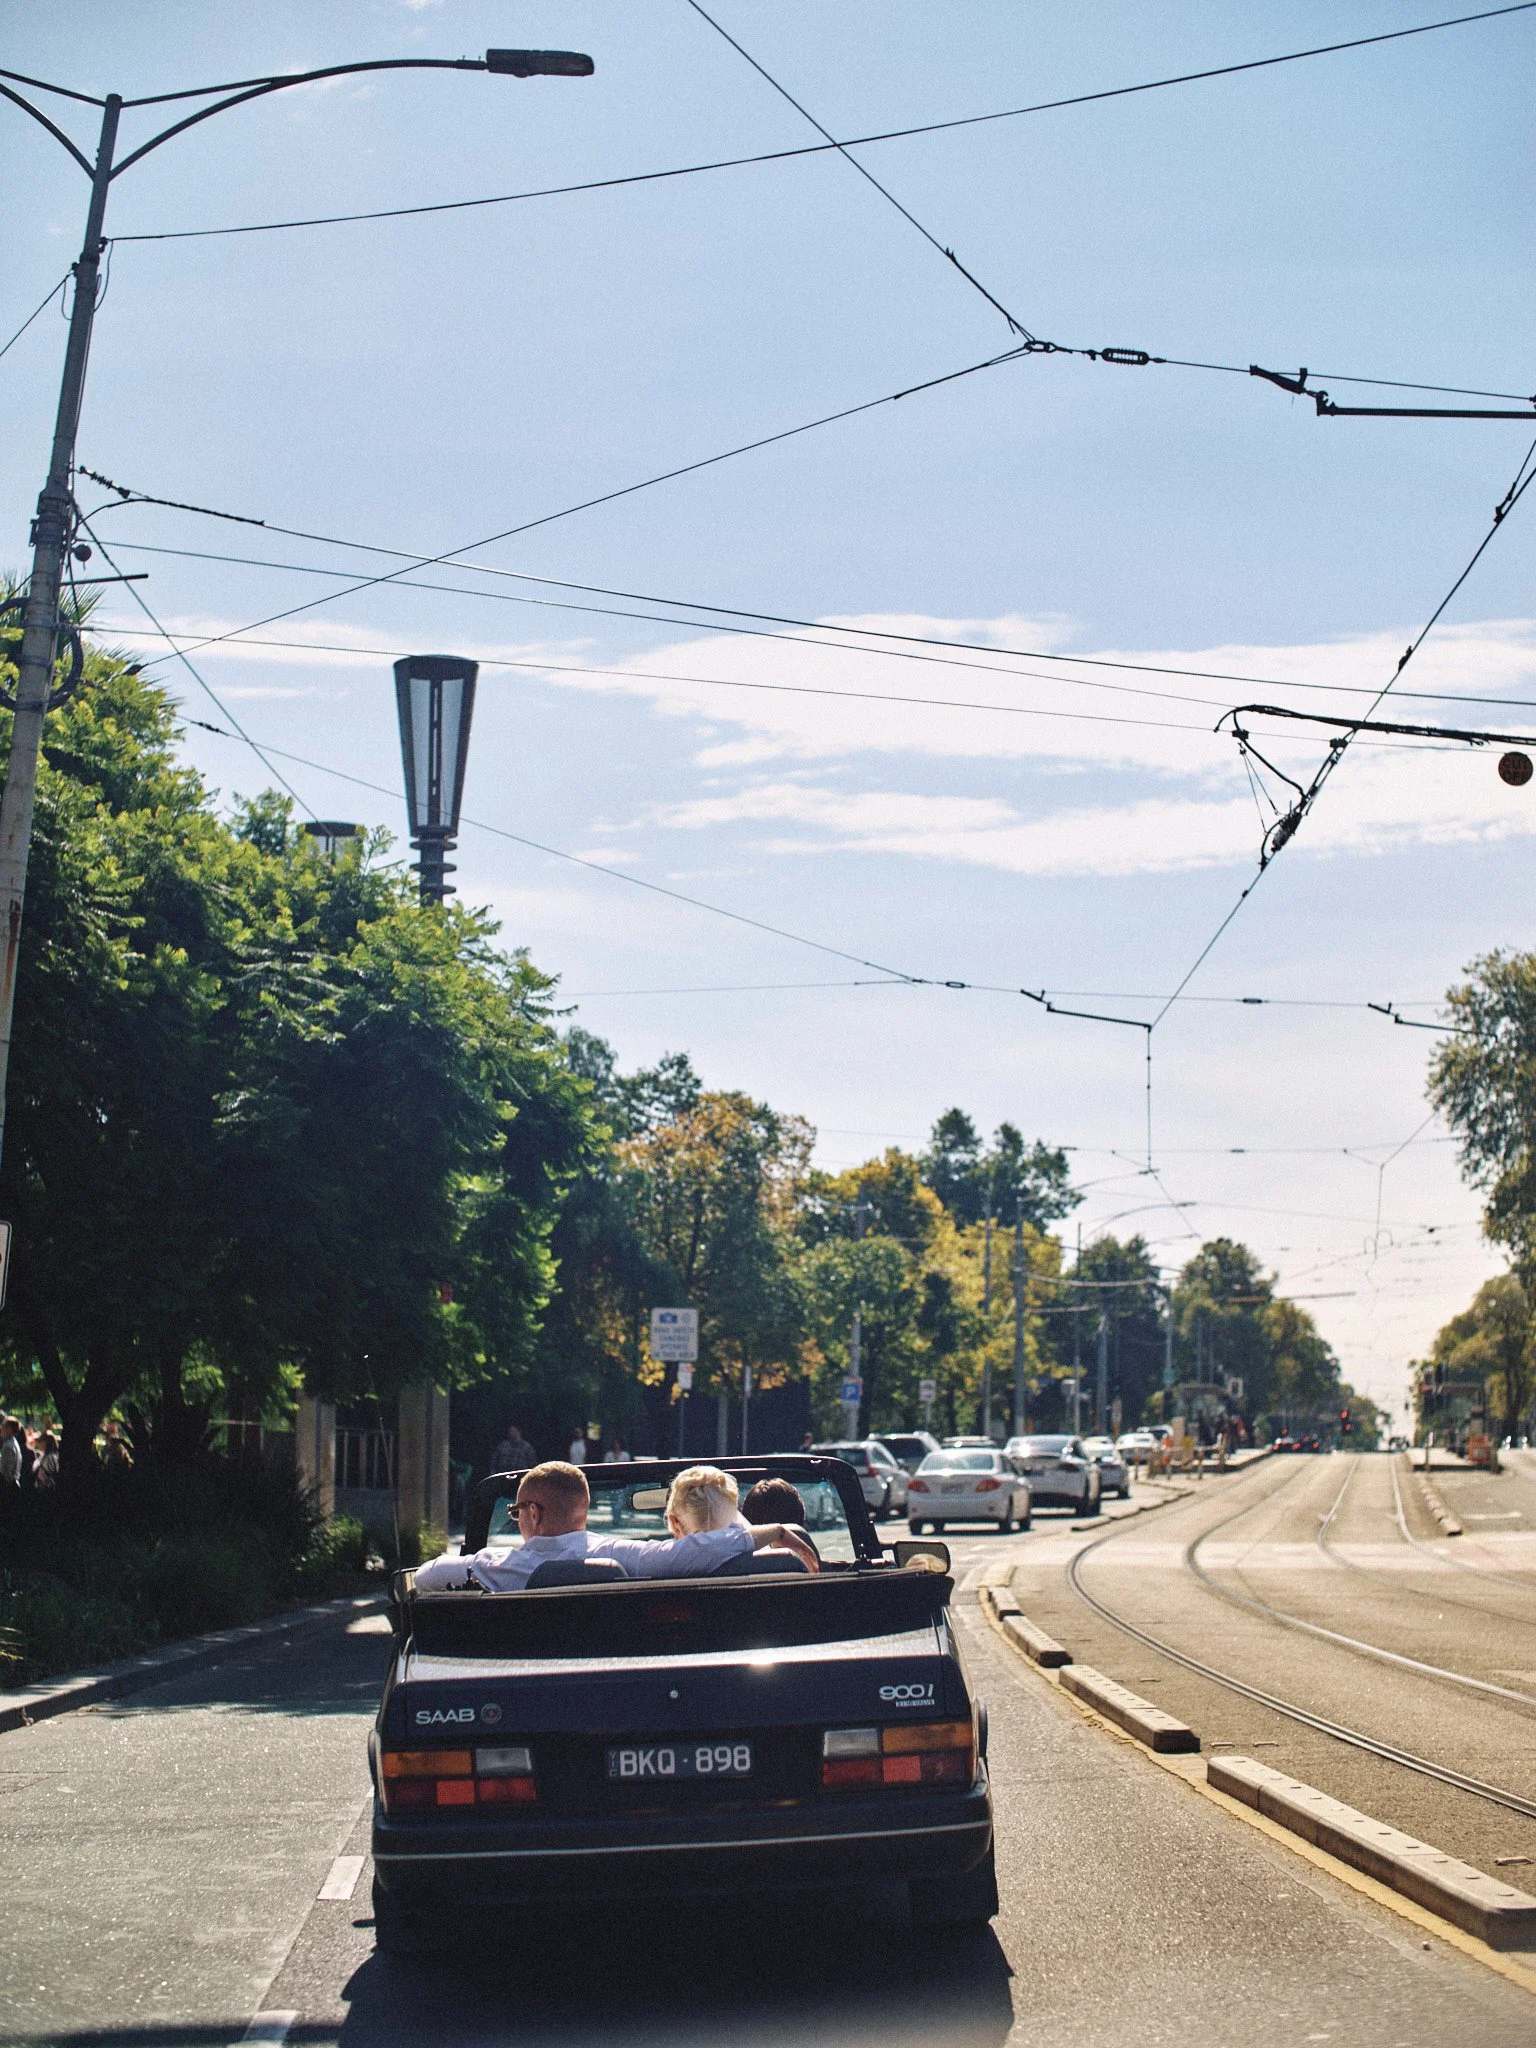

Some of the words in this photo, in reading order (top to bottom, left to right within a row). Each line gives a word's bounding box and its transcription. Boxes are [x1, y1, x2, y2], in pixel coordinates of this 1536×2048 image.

[415, 1708, 476, 1725] SAAB
[619, 1749, 676, 1777] BKQ
[695, 1745, 751, 1772] 898
